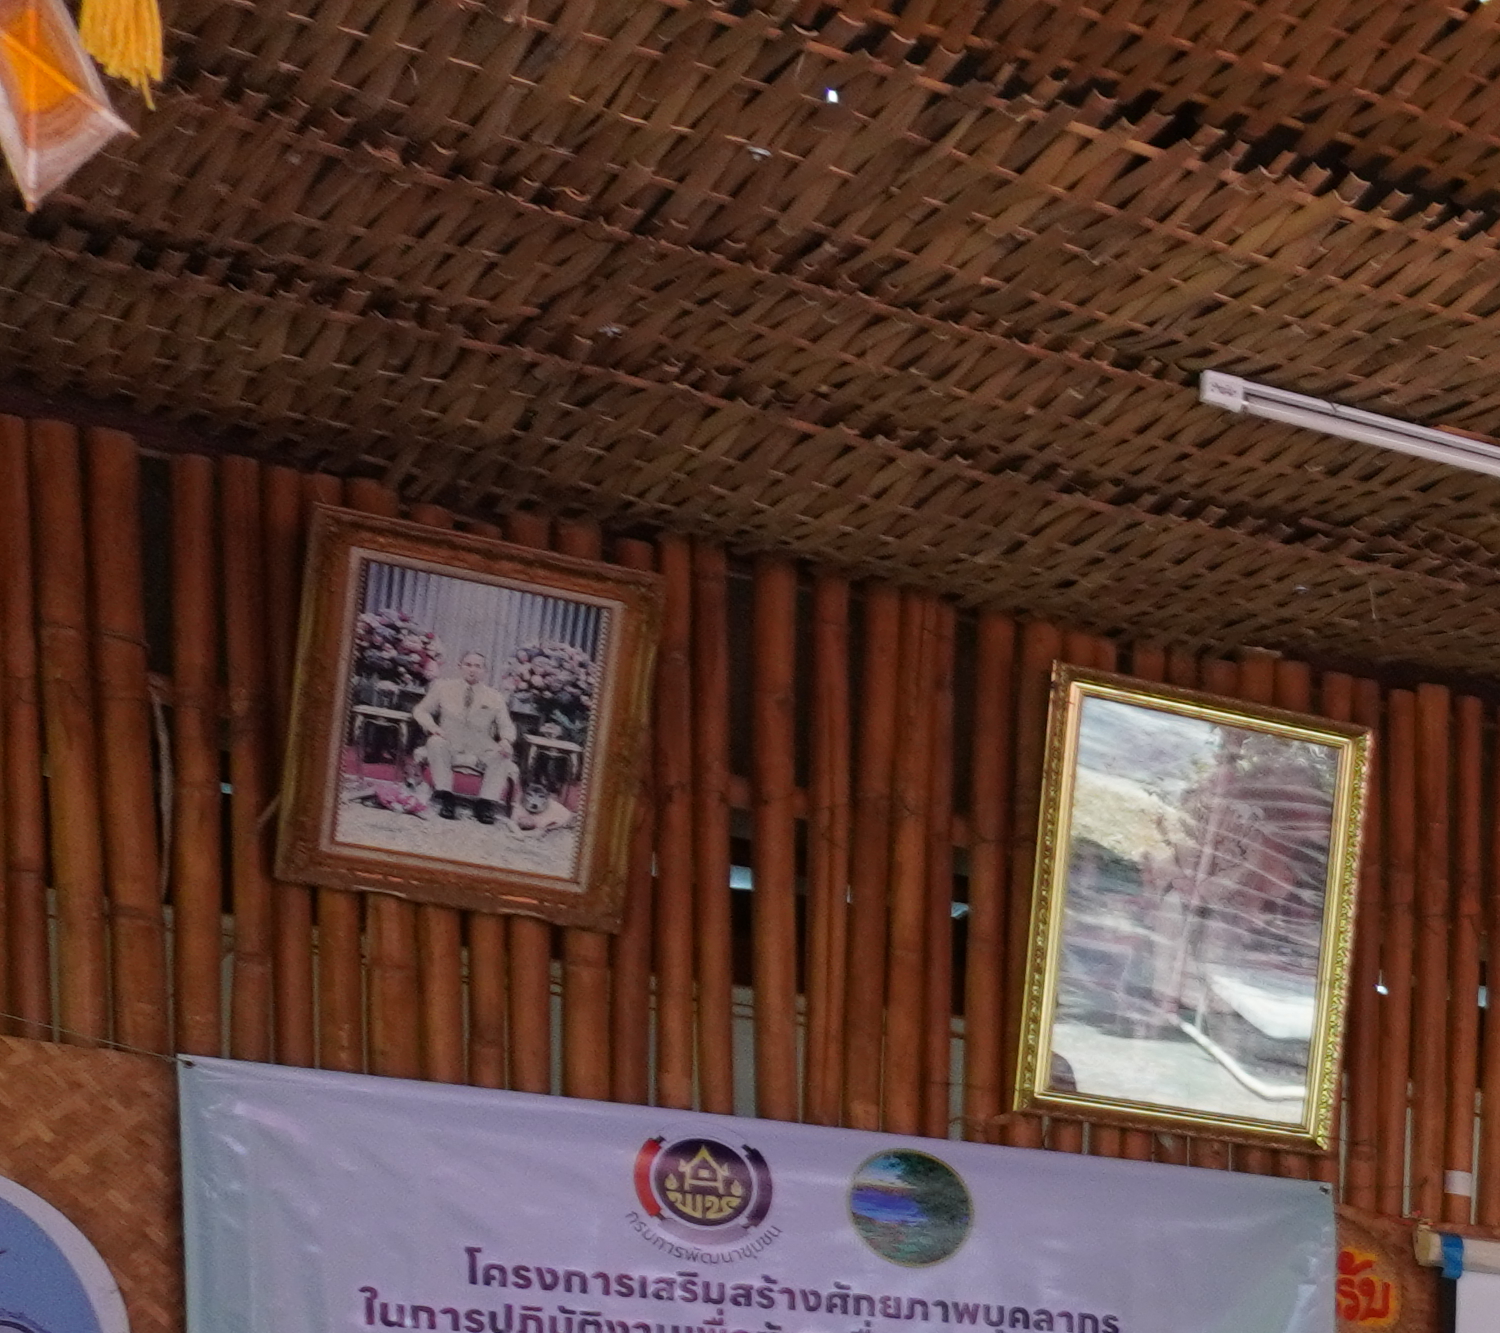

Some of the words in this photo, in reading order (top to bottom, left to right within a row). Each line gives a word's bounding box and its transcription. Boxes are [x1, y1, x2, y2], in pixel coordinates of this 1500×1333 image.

[624, 1210, 783, 1265] กรมการพัฒนาชุมชน
